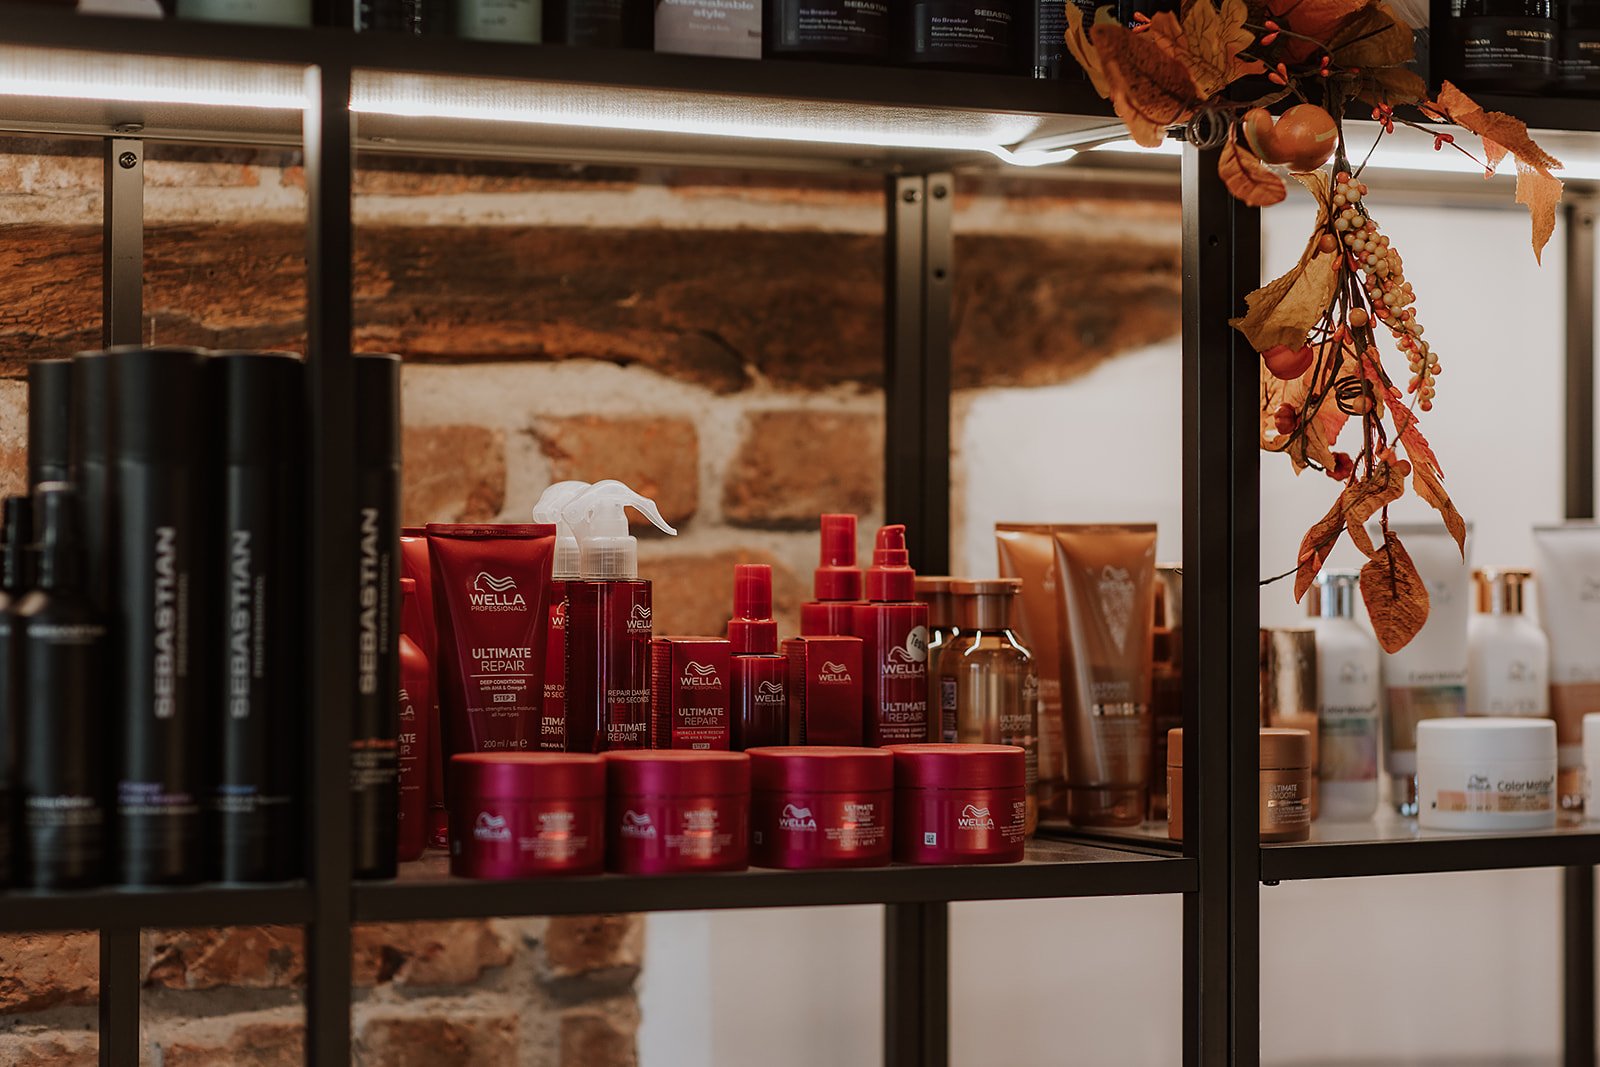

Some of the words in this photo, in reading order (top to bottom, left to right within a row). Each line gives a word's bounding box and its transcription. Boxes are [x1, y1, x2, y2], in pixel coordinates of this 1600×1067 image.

[359, 508, 379, 694] SEBASTIAN
[469, 594, 526, 606] WELLA
[154, 526, 176, 719] SEBASTIAN
[230, 530, 251, 719] SEBASTIAN
[472, 648, 531, 659] ULTIMATE
[481, 661, 525, 671] REPAIR
[881, 664, 924, 674] WELLA
[680, 677, 722, 686] WELLA
[818, 674, 851, 682] WELLA
[608, 689, 631, 697] REPAIR
[755, 694, 785, 702] WELLA
[678, 708, 724, 716] ULTIMATE
[684, 717, 719, 726] REPAIR
[889, 713, 923, 722] REPAIR
[608, 723, 646, 732] ULTIMATE
[608, 733, 637, 742] REPAIR
[484, 740, 496, 748] 200
[779, 818, 816, 828] WELLA
[958, 818, 994, 827] WELLA
